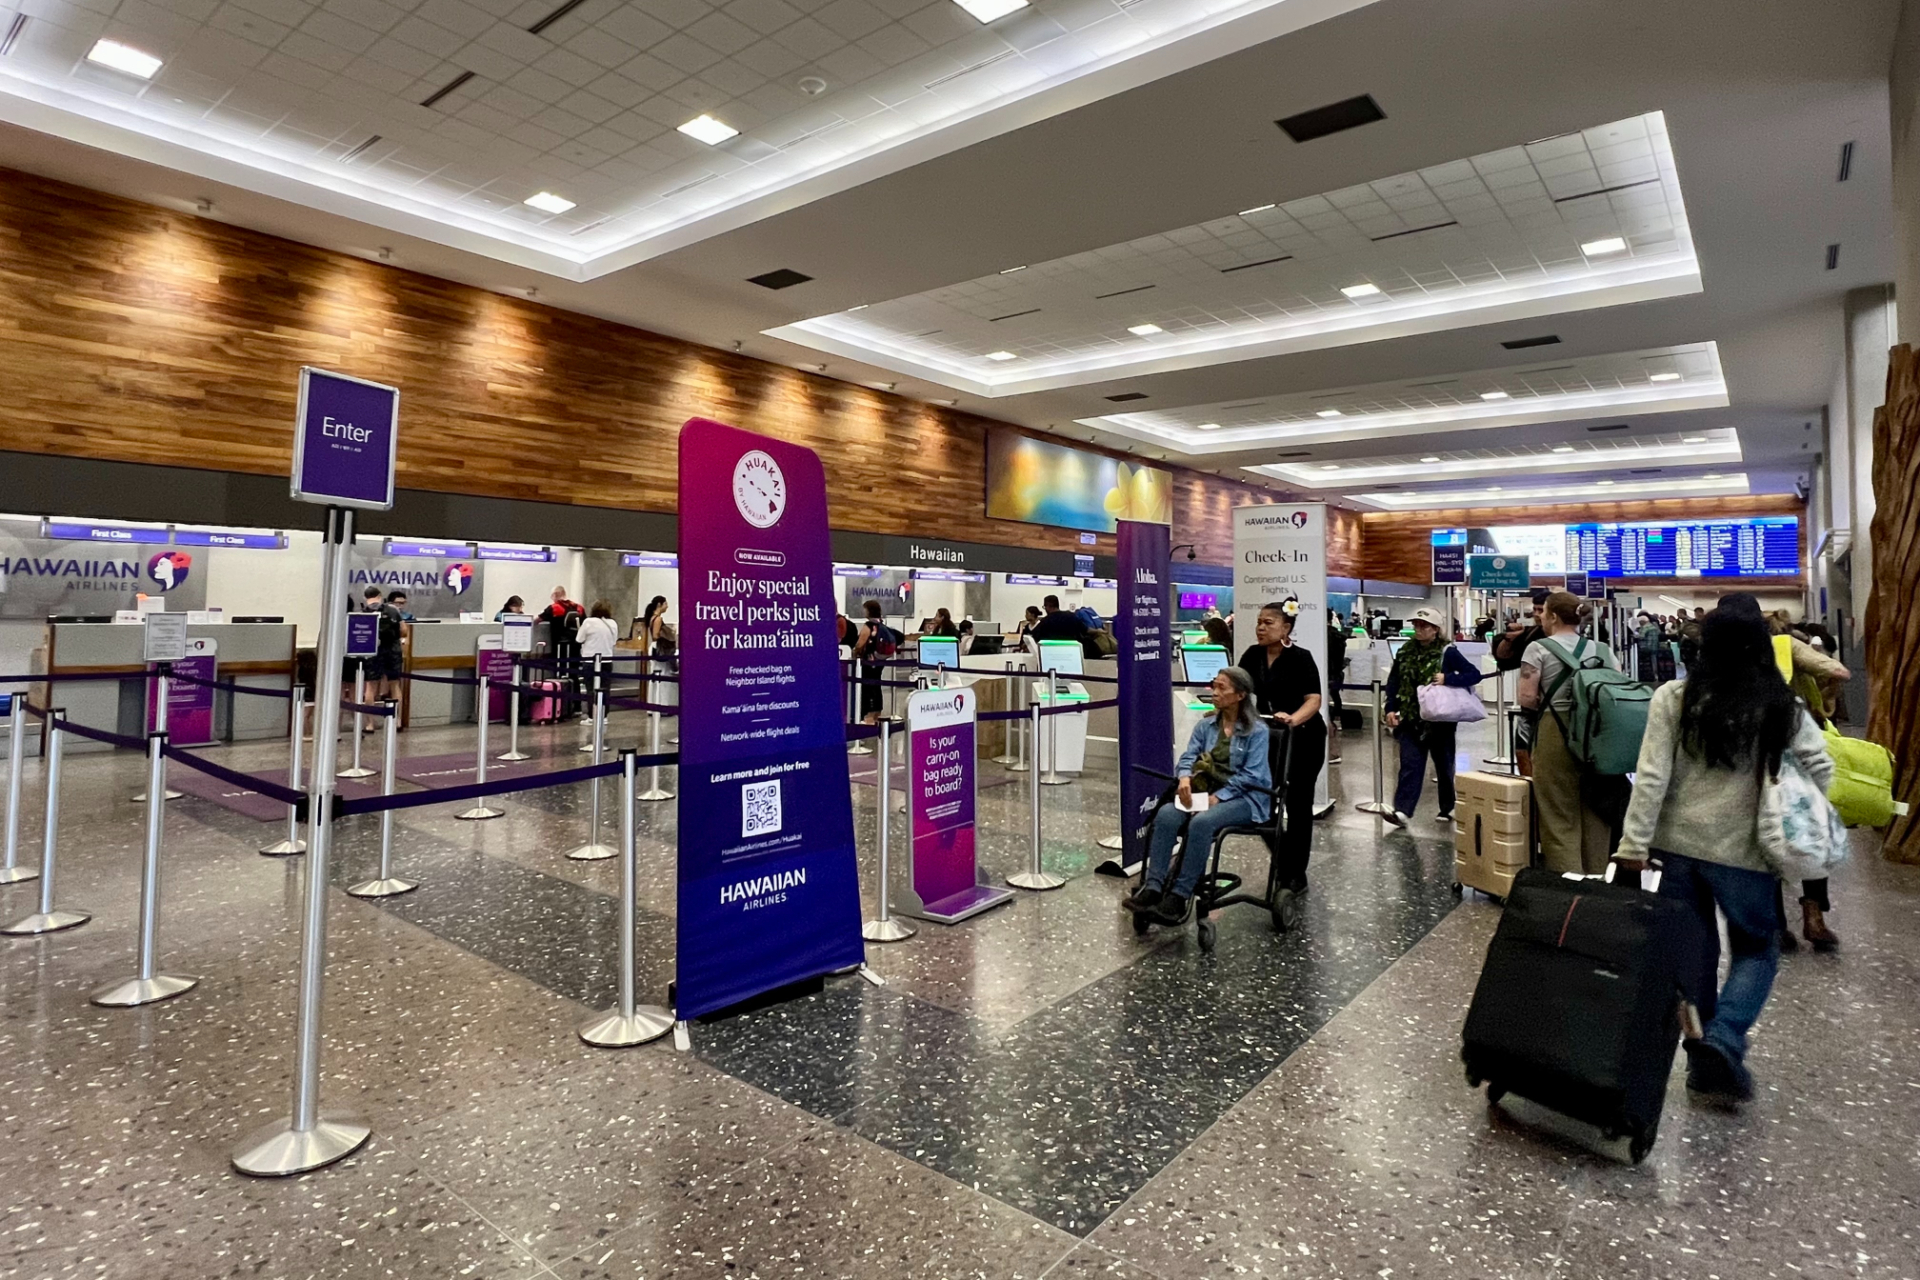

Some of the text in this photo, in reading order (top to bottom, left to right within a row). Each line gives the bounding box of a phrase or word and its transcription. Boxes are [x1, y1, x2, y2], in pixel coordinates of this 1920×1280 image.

[322, 416, 373, 443] Enter
[741, 500, 766, 520] HAWAIIAN
[1245, 517, 1289, 526] HAWAIIAN
[92, 529, 132, 539] First Class
[209, 536, 245, 544] First Class
[738, 552, 781, 562] NOW AVAILABLE
[911, 545, 964, 562] Hawaiian
[1245, 549, 1308, 563] Check-In
[1134, 568, 1158, 584] Aloha.
[1243, 575, 1308, 584] Continental U.S.
[66, 581, 138, 591] AIRLINES
[707, 570, 810, 599] Enjoy special
[1261, 585, 1289, 595] Flights
[852, 587, 896, 597] HAWAIIAN
[695, 600, 821, 626] travel perks just
[1299, 602, 1317, 613] ghts
[704, 627, 730, 649] for
[729, 666, 743, 674] Free
[744, 665, 770, 674] checked
[770, 665, 783, 674] bag
[725, 675, 796, 688] Neighbor Island flights
[756, 702, 769, 711] fare
[768, 701, 800, 710] discounts
[920, 701, 953, 714] HAWAIIAN
[766, 726, 784, 738] flight
[784, 725, 800, 735] deals
[929, 735, 956, 750] Is your
[926, 750, 960, 766] carry-on
[710, 761, 810, 783] Learn more and join for free
[923, 763, 963, 782] bag ready
[925, 778, 963, 798] to board?
[720, 867, 806, 905] HAWAIIAN
[743, 892, 787, 912] AIRLINES
